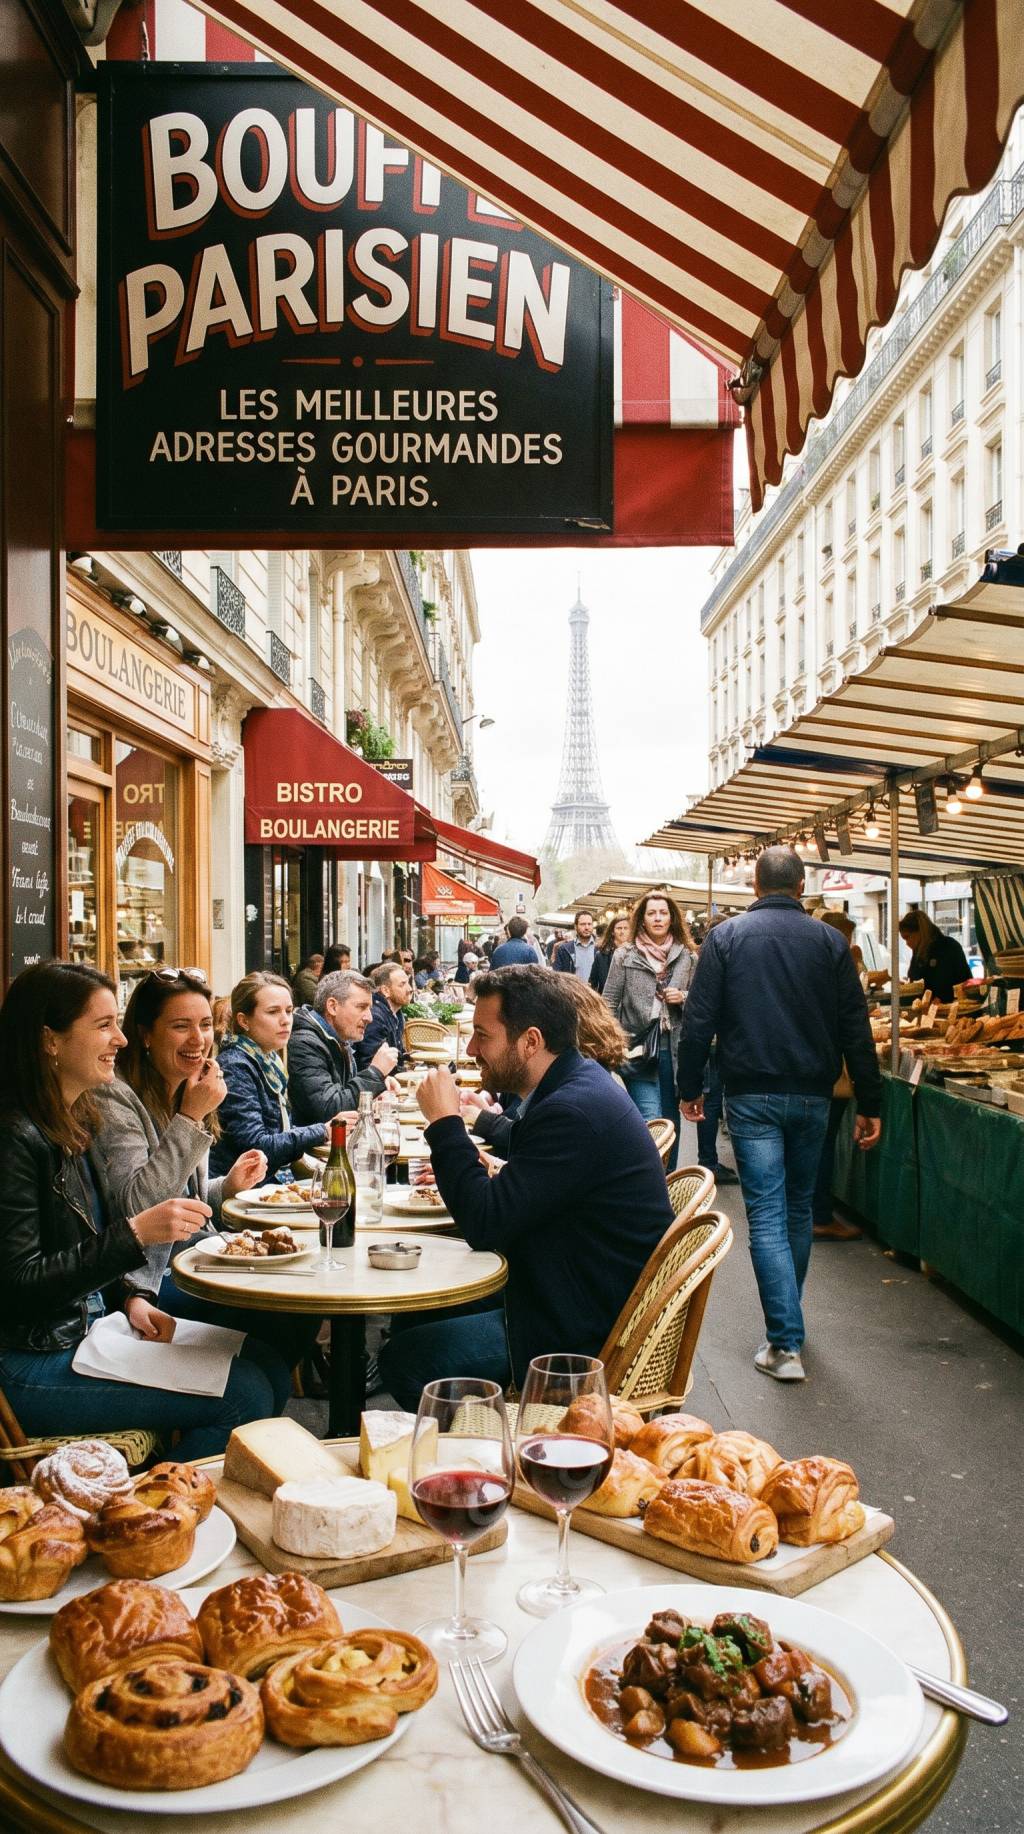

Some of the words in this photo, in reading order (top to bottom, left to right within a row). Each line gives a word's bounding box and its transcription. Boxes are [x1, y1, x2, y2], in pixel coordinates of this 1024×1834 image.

[145, 106, 523, 238] BOUF
[124, 228, 571, 386] PARISIEN
[220, 389, 279, 420] LES
[296, 389, 499, 422] MEILLEURES
[149, 431, 317, 463] ADRESSES
[331, 432, 563, 465] GOURMANDES
[290, 466, 315, 506] À
[332, 475, 438, 507] PARIS.
[66, 608, 186, 720] BOULANGERIE
[276, 782, 363, 804] BISTRO
[260, 818, 400, 839] BOULANGERIE
